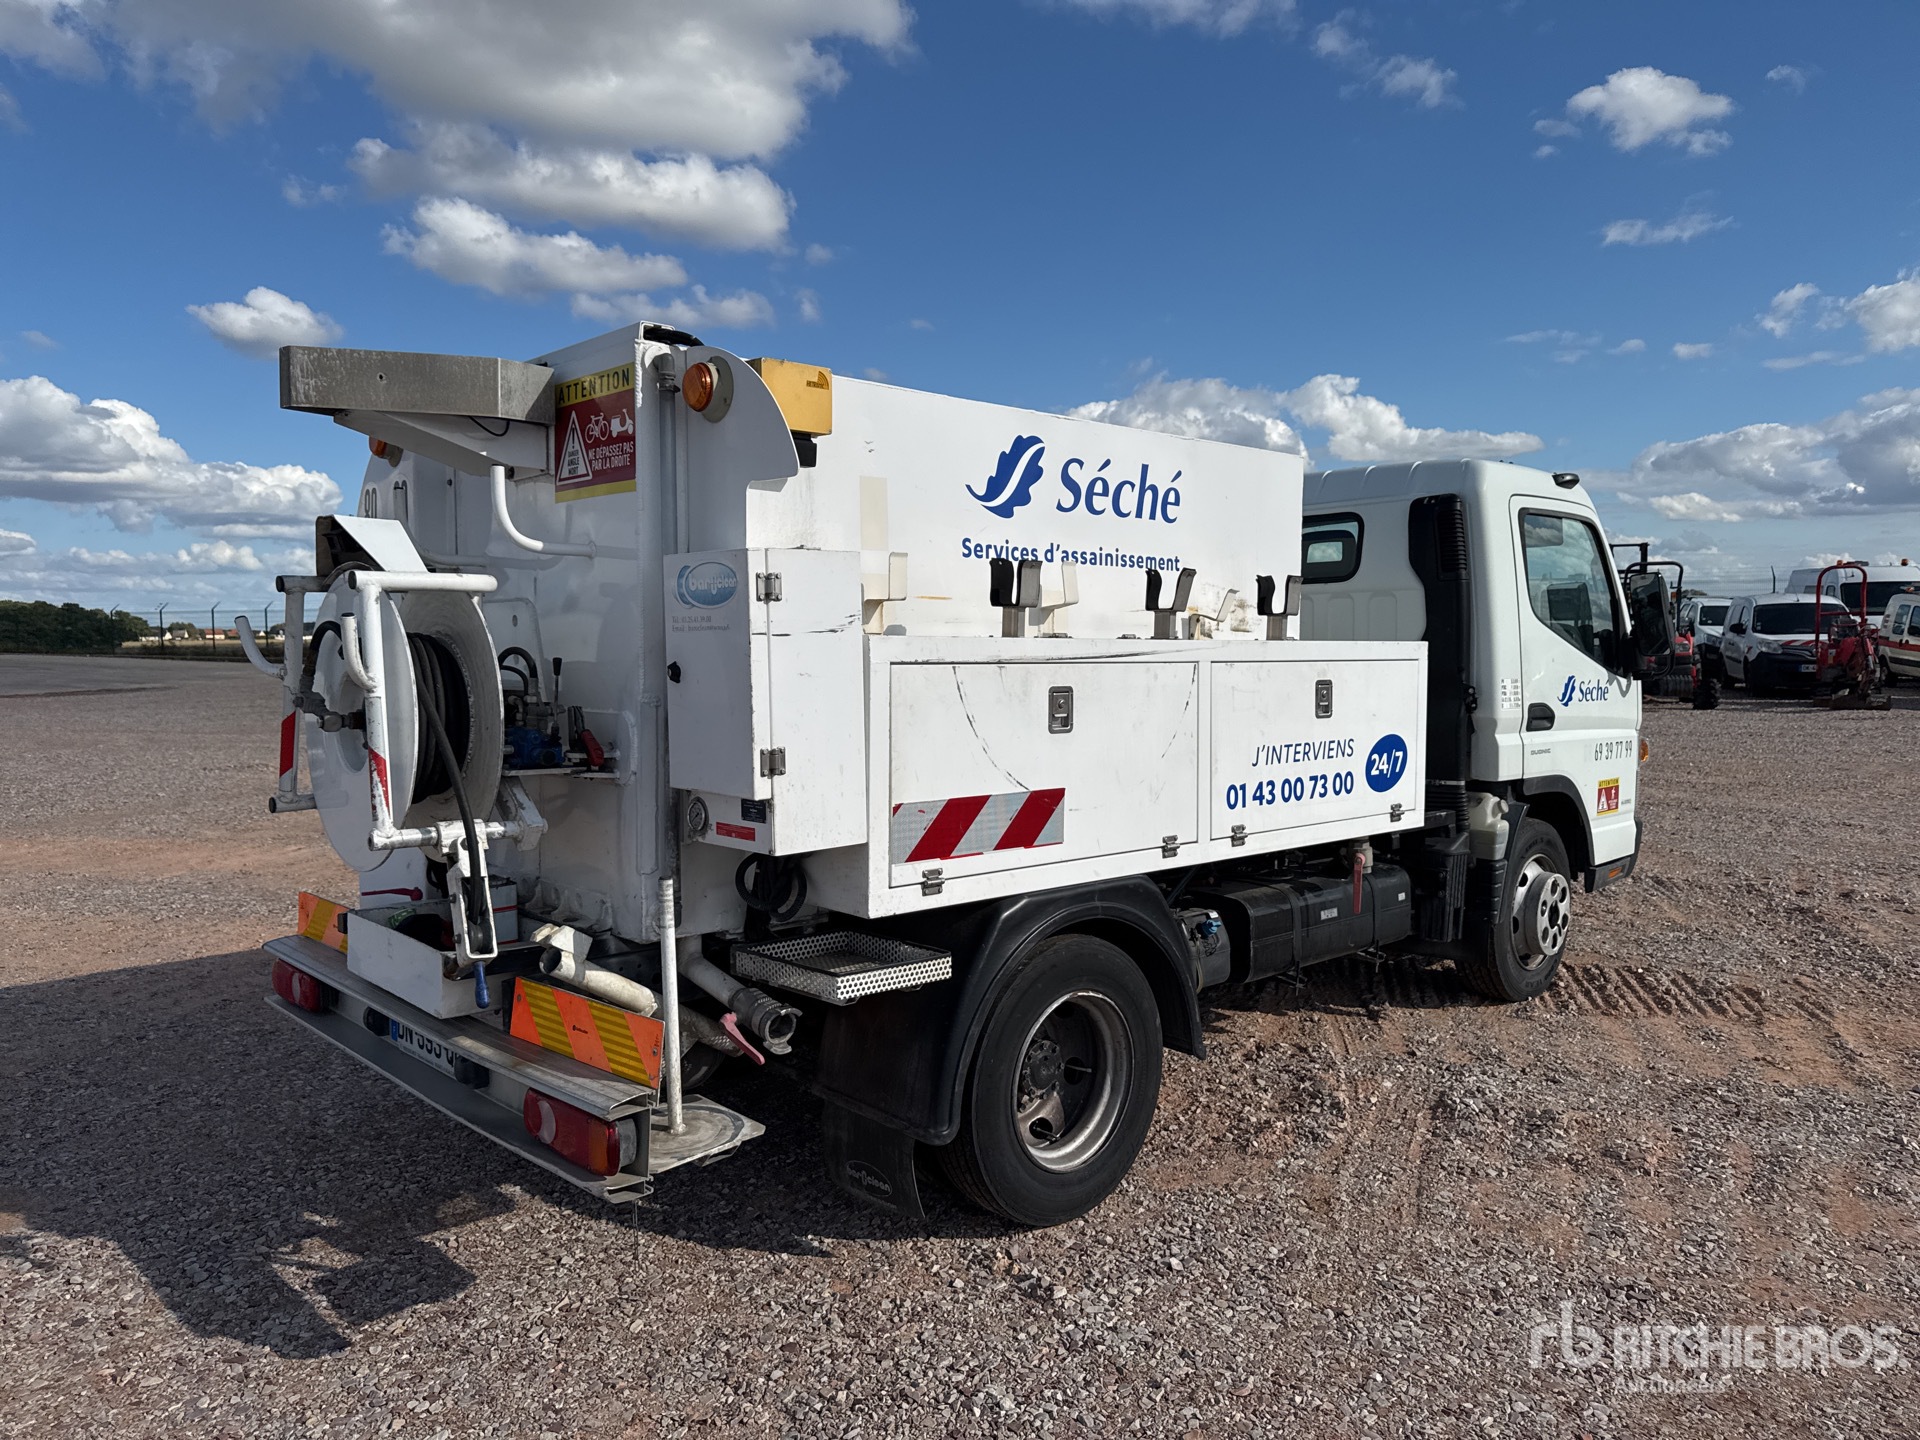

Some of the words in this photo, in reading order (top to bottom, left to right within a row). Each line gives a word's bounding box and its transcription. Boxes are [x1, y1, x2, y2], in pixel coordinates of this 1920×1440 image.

[559, 367, 630, 404] ATTENTION
[567, 457, 580, 466] ANGLE
[588, 448, 596, 460] NE
[596, 444, 622, 459] DÉPASSEZ
[623, 441, 634, 453] PAS
[567, 466, 579, 475] MORT
[592, 458, 602, 471] PAR
[603, 457, 610, 469] LA
[611, 454, 630, 468] DROITE
[1056, 457, 1182, 523] Séché
[961, 537, 1038, 561] Services
[1044, 542, 1180, 572] d'assainissement
[1578, 679, 1609, 702] Séché
[1252, 738, 1355, 767] J'INTERVIENS
[1530, 748, 1551, 756] DUONIC
[1595, 743, 1603, 761] 69
[1605, 742, 1613, 760] 39
[1615, 741, 1623, 759] 77
[1625, 740, 1632, 758] 99
[1370, 749, 1404, 778] 24/7
[1226, 782, 1247, 810] 01
[1252, 779, 1276, 806] 43
[1280, 776, 1304, 803] 00
[1309, 773, 1328, 799] 73
[1332, 771, 1354, 796] 00
[1598, 778, 1619, 787] ATTENTION
